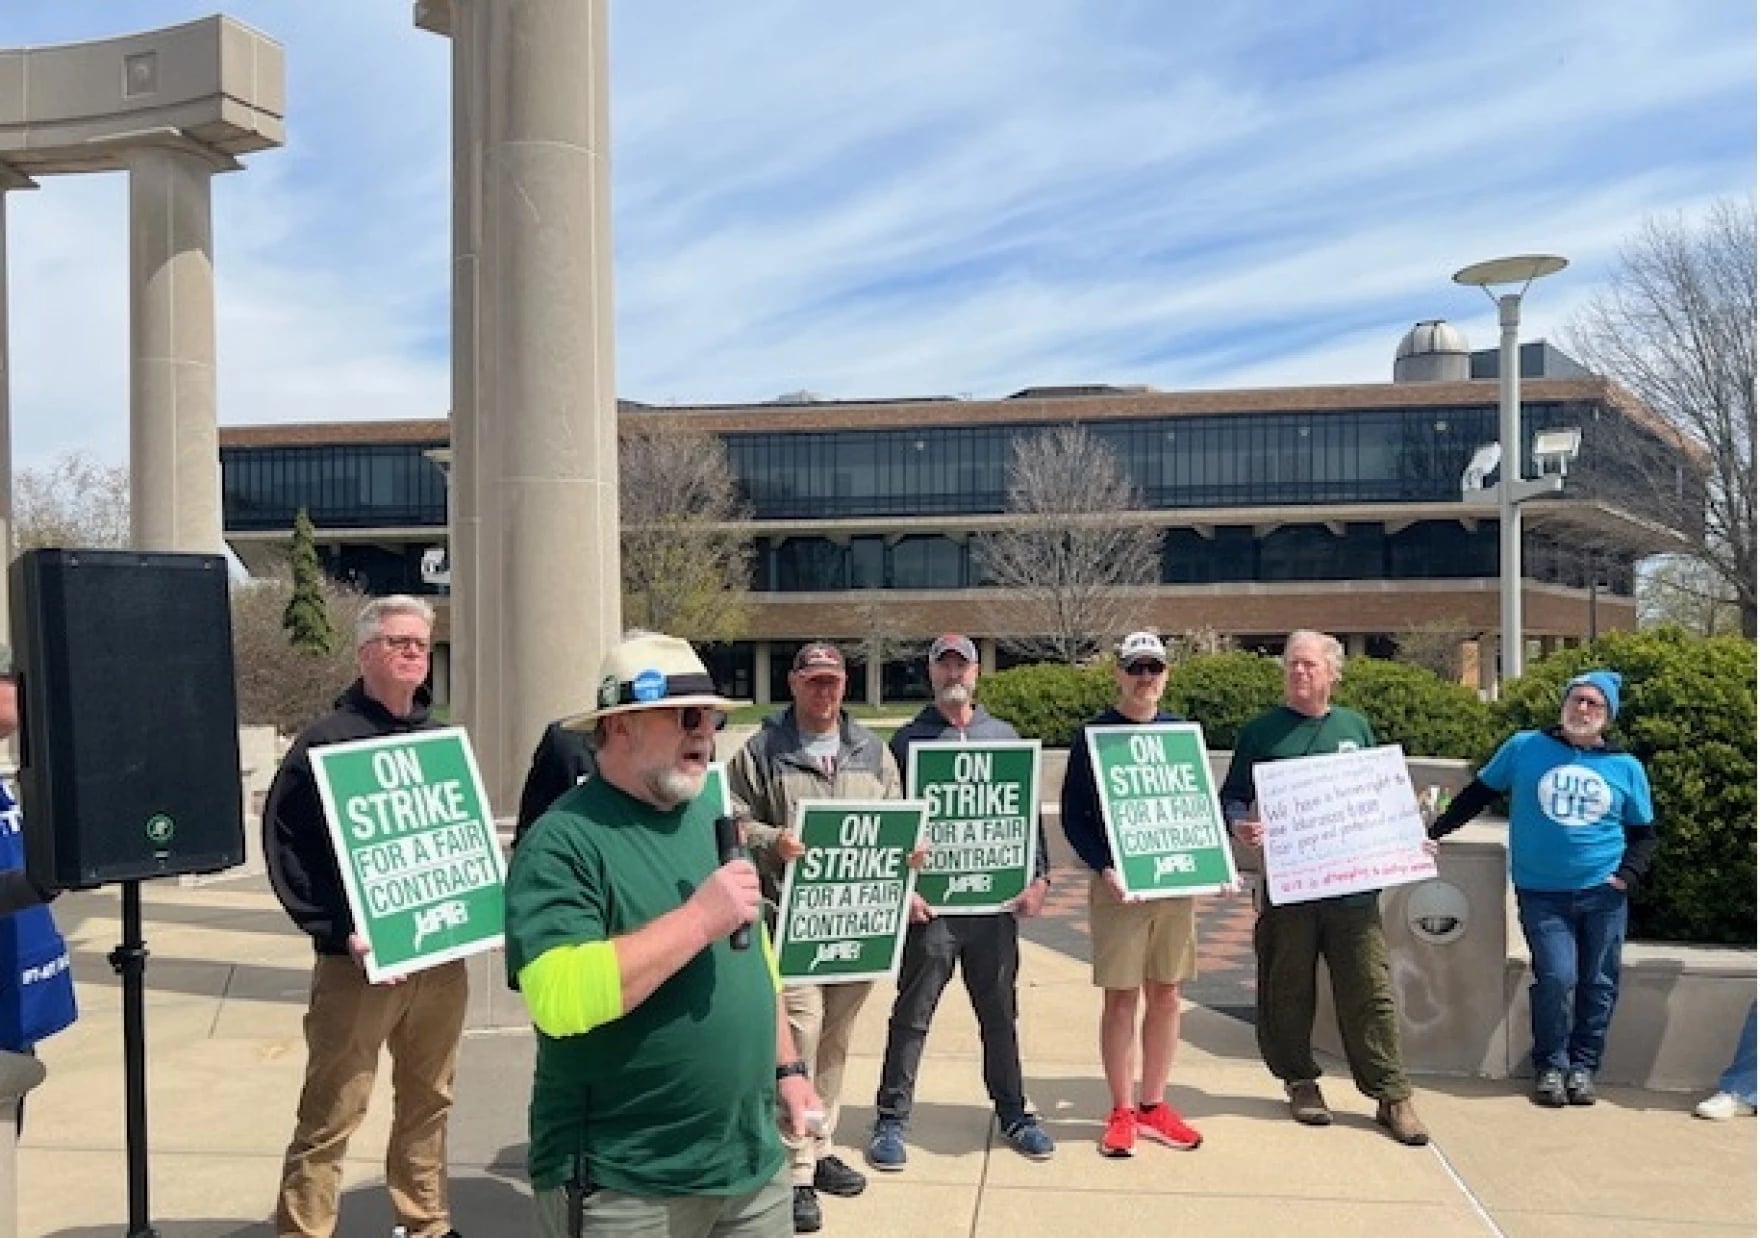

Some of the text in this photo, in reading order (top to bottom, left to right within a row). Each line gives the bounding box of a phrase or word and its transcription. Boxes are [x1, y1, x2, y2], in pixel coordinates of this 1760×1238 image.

[1130, 735, 1166, 763] ON
[372, 747, 424, 789] ON
[954, 753, 993, 783] ON
[1109, 762, 1199, 796] STRIKE
[923, 781, 1020, 816] STRIKE
[1552, 773, 1600, 796] UIC
[346, 779, 470, 840] STRIKE
[1117, 796, 1211, 826] FOR A FAIR
[839, 813, 881, 847] ON
[962, 821, 976, 843] A
[983, 818, 1022, 841] FAIR
[1123, 824, 1220, 852] CONTRACT
[356, 824, 484, 878] FOR A FAIR
[802, 847, 903, 880] STRIKE
[371, 855, 492, 913] CONTRACT
[793, 882, 902, 910] FOR A FAIR
[791, 908, 897, 939] CONTRACT
